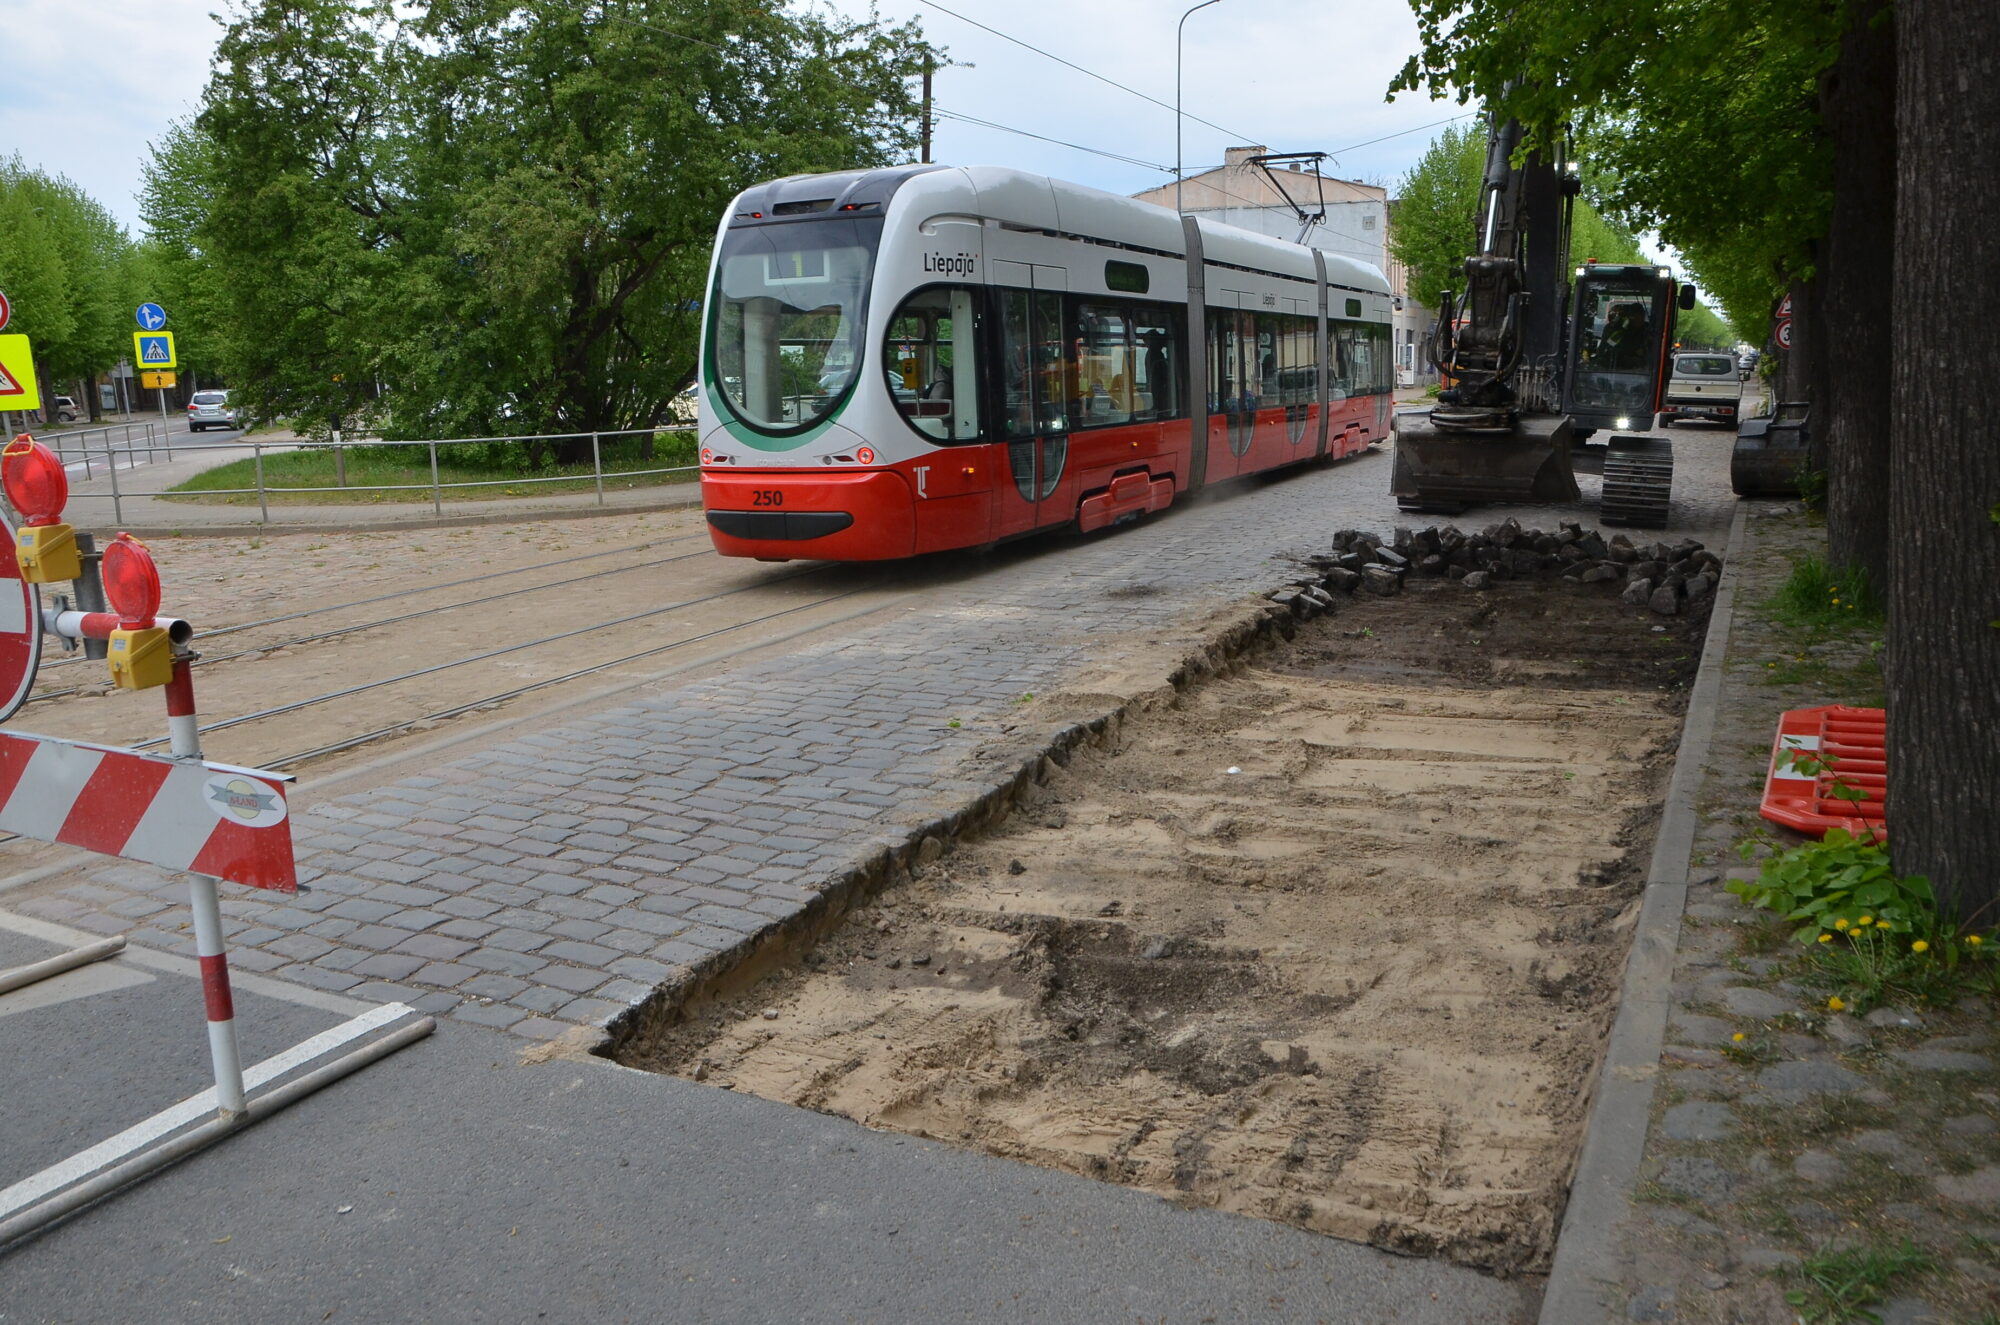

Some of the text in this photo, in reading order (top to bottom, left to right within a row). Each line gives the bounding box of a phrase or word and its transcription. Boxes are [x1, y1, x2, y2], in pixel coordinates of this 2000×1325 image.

[792, 252, 803, 278] 1
[924, 251, 974, 278] Liepāja
[1783, 326, 1791, 342] 3
[752, 490, 783, 506] 250
